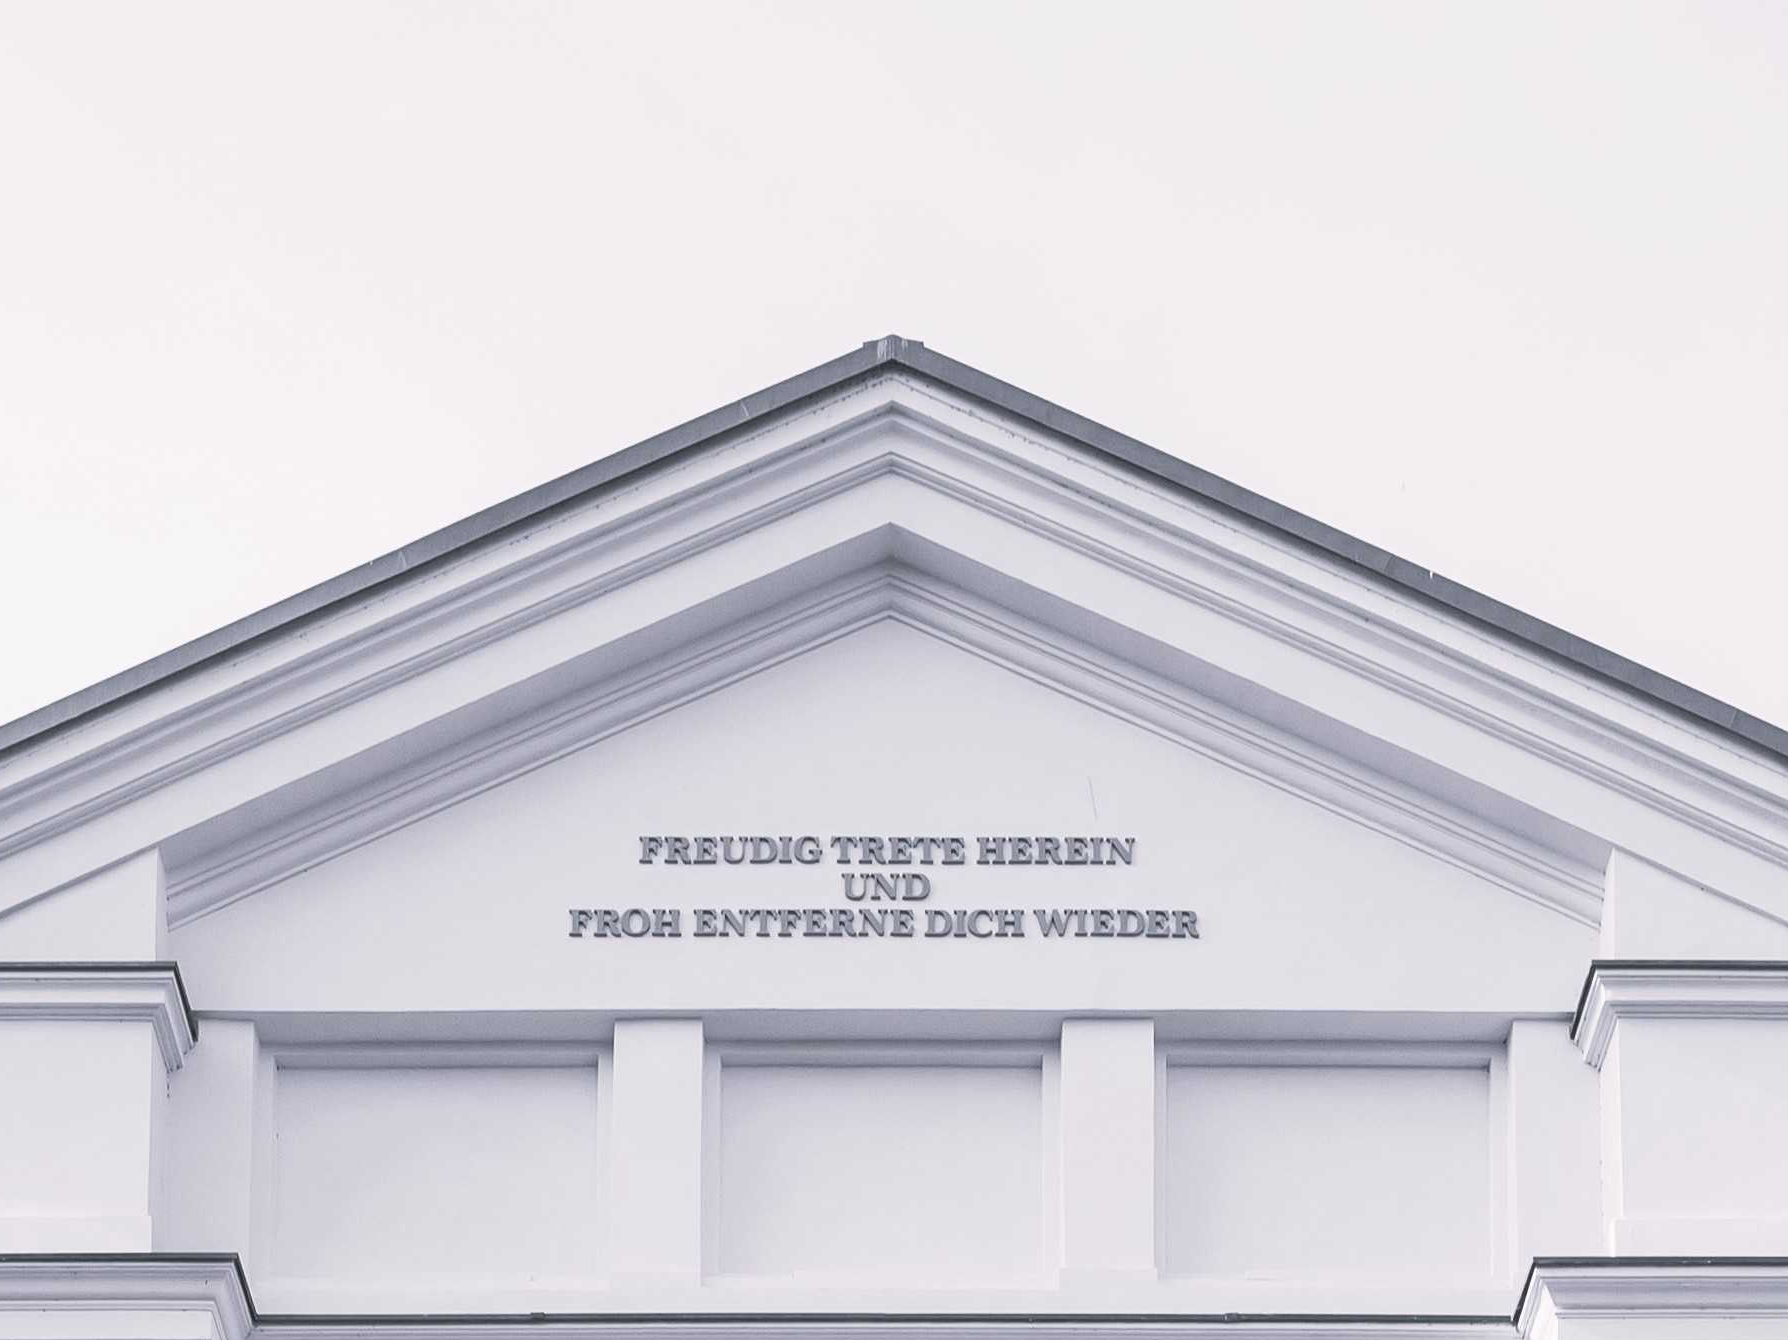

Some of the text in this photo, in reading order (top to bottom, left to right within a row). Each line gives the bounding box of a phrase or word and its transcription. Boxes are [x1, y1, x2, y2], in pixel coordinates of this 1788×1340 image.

[639, 836, 1136, 866] FREUDIG TRETE HEREIN
[841, 873, 931, 902] UND
[569, 909, 1200, 939] FROH ENTFERNE DICH WIEDER
